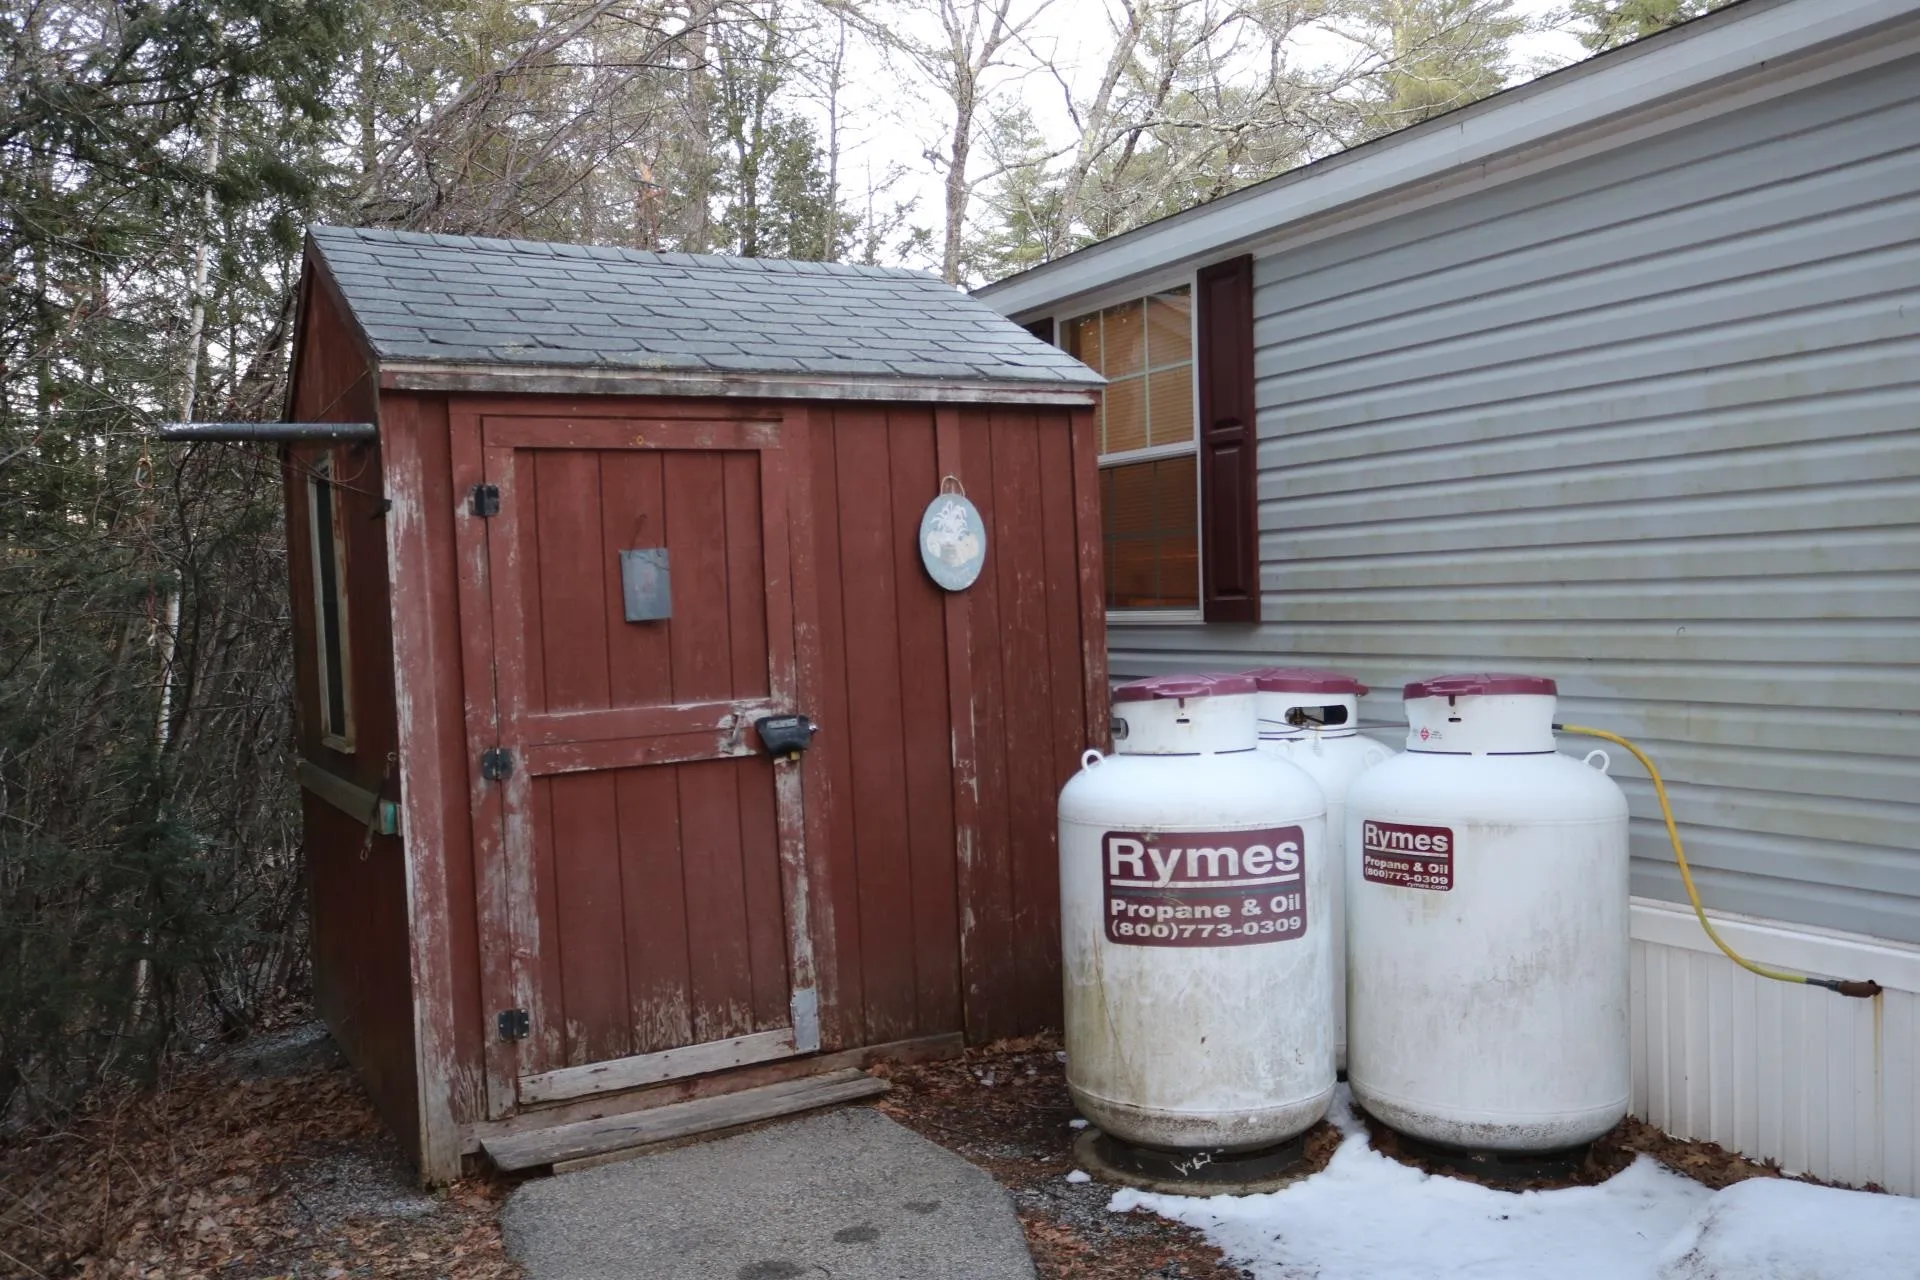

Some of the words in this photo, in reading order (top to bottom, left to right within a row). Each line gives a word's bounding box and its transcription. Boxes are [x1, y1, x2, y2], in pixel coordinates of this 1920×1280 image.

[1365, 824, 1448, 852] Rymes
[1109, 838, 1300, 888] Rymes
[1365, 855, 1409, 871] Propane
[1413, 862, 1423, 872] &
[1428, 864, 1448, 874] Oil
[1365, 867, 1448, 885] (800)773-0309
[1407, 882, 1448, 890] rymes.com
[1111, 899, 1231, 921] Propane
[1241, 899, 1262, 916] &
[1270, 893, 1300, 913] Oil
[1111, 917, 1301, 940] (800)773-0309
